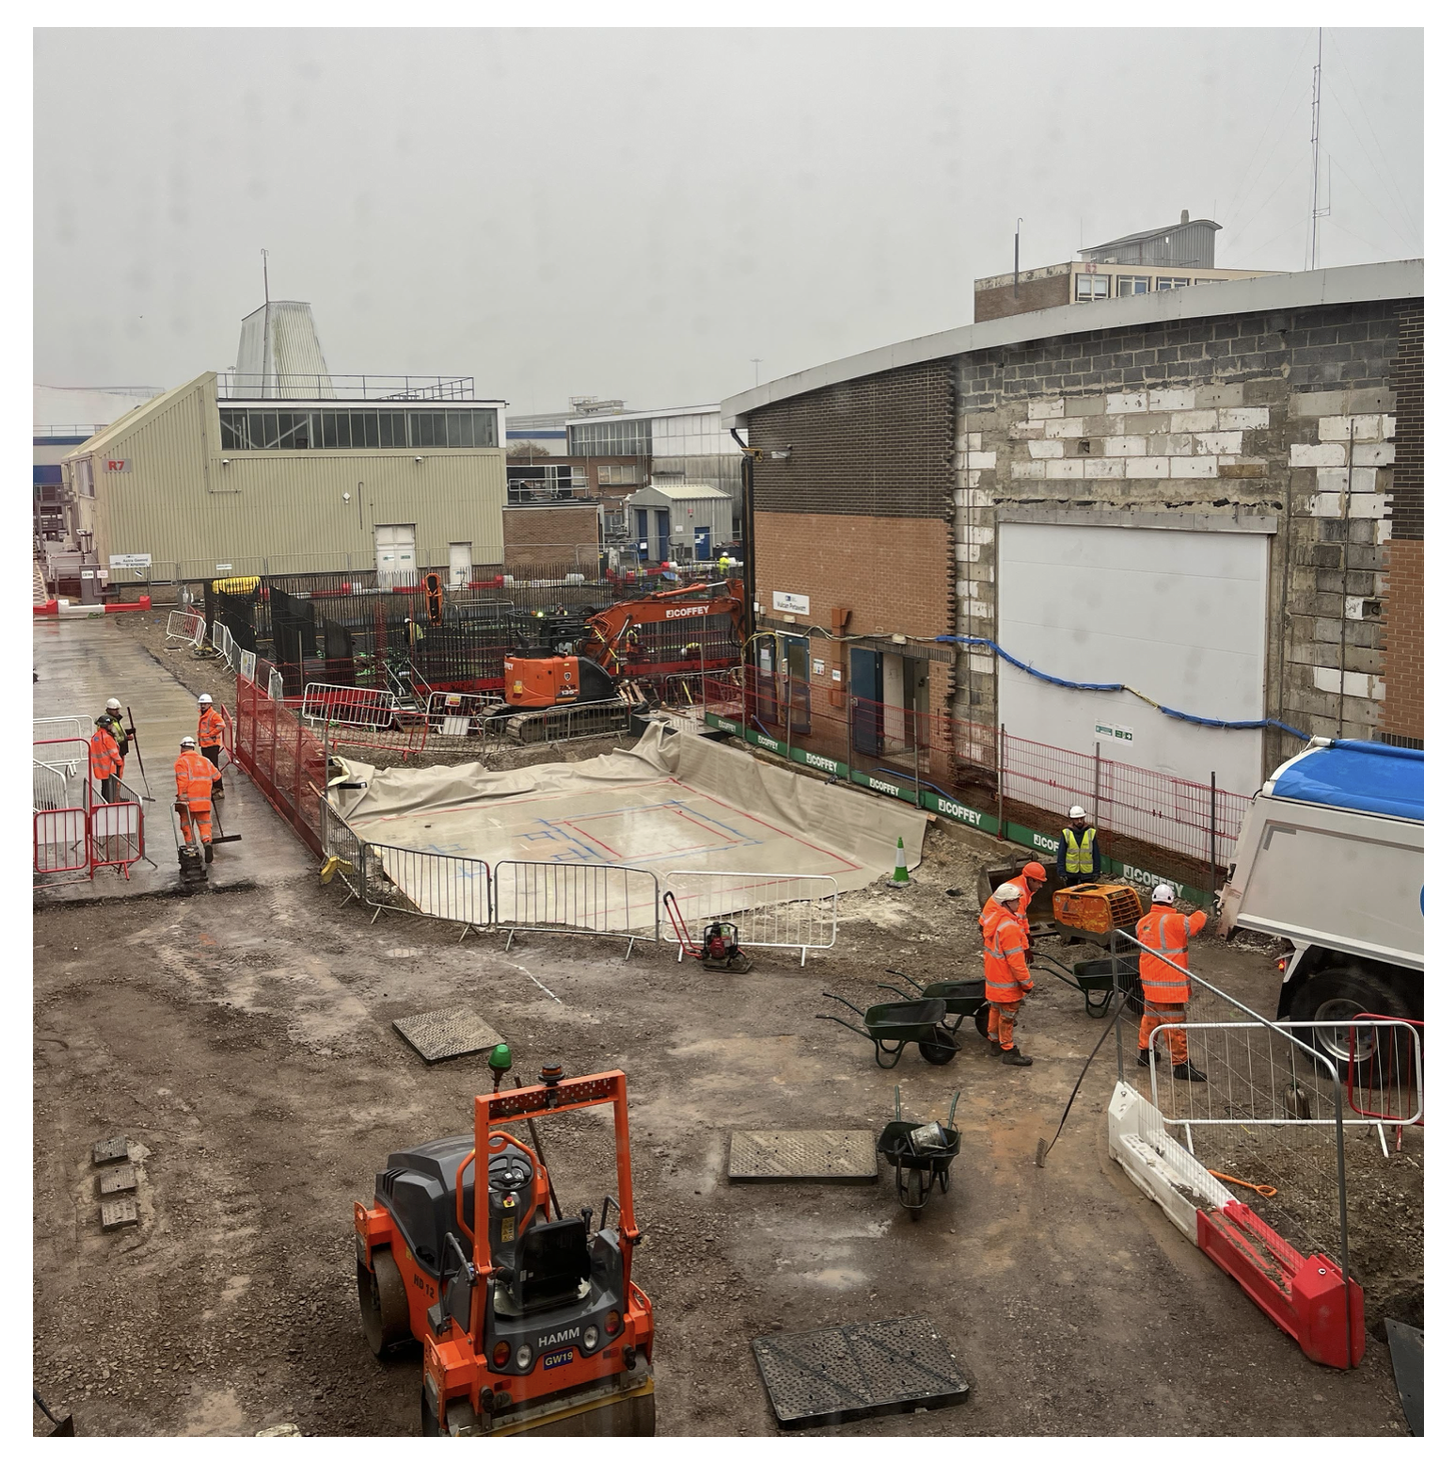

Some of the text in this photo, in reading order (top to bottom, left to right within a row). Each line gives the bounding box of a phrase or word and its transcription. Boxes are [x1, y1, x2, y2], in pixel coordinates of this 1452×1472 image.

[108, 461, 125, 471] R7
[674, 605, 710, 617] COFFEY
[812, 754, 838, 773] COFFEY
[875, 778, 900, 796] COFFEY
[945, 801, 982, 825] COFFEY
[425, 1283, 435, 1299] 12
[538, 1327, 581, 1348] HAMM
[544, 1351, 574, 1367] GW19
